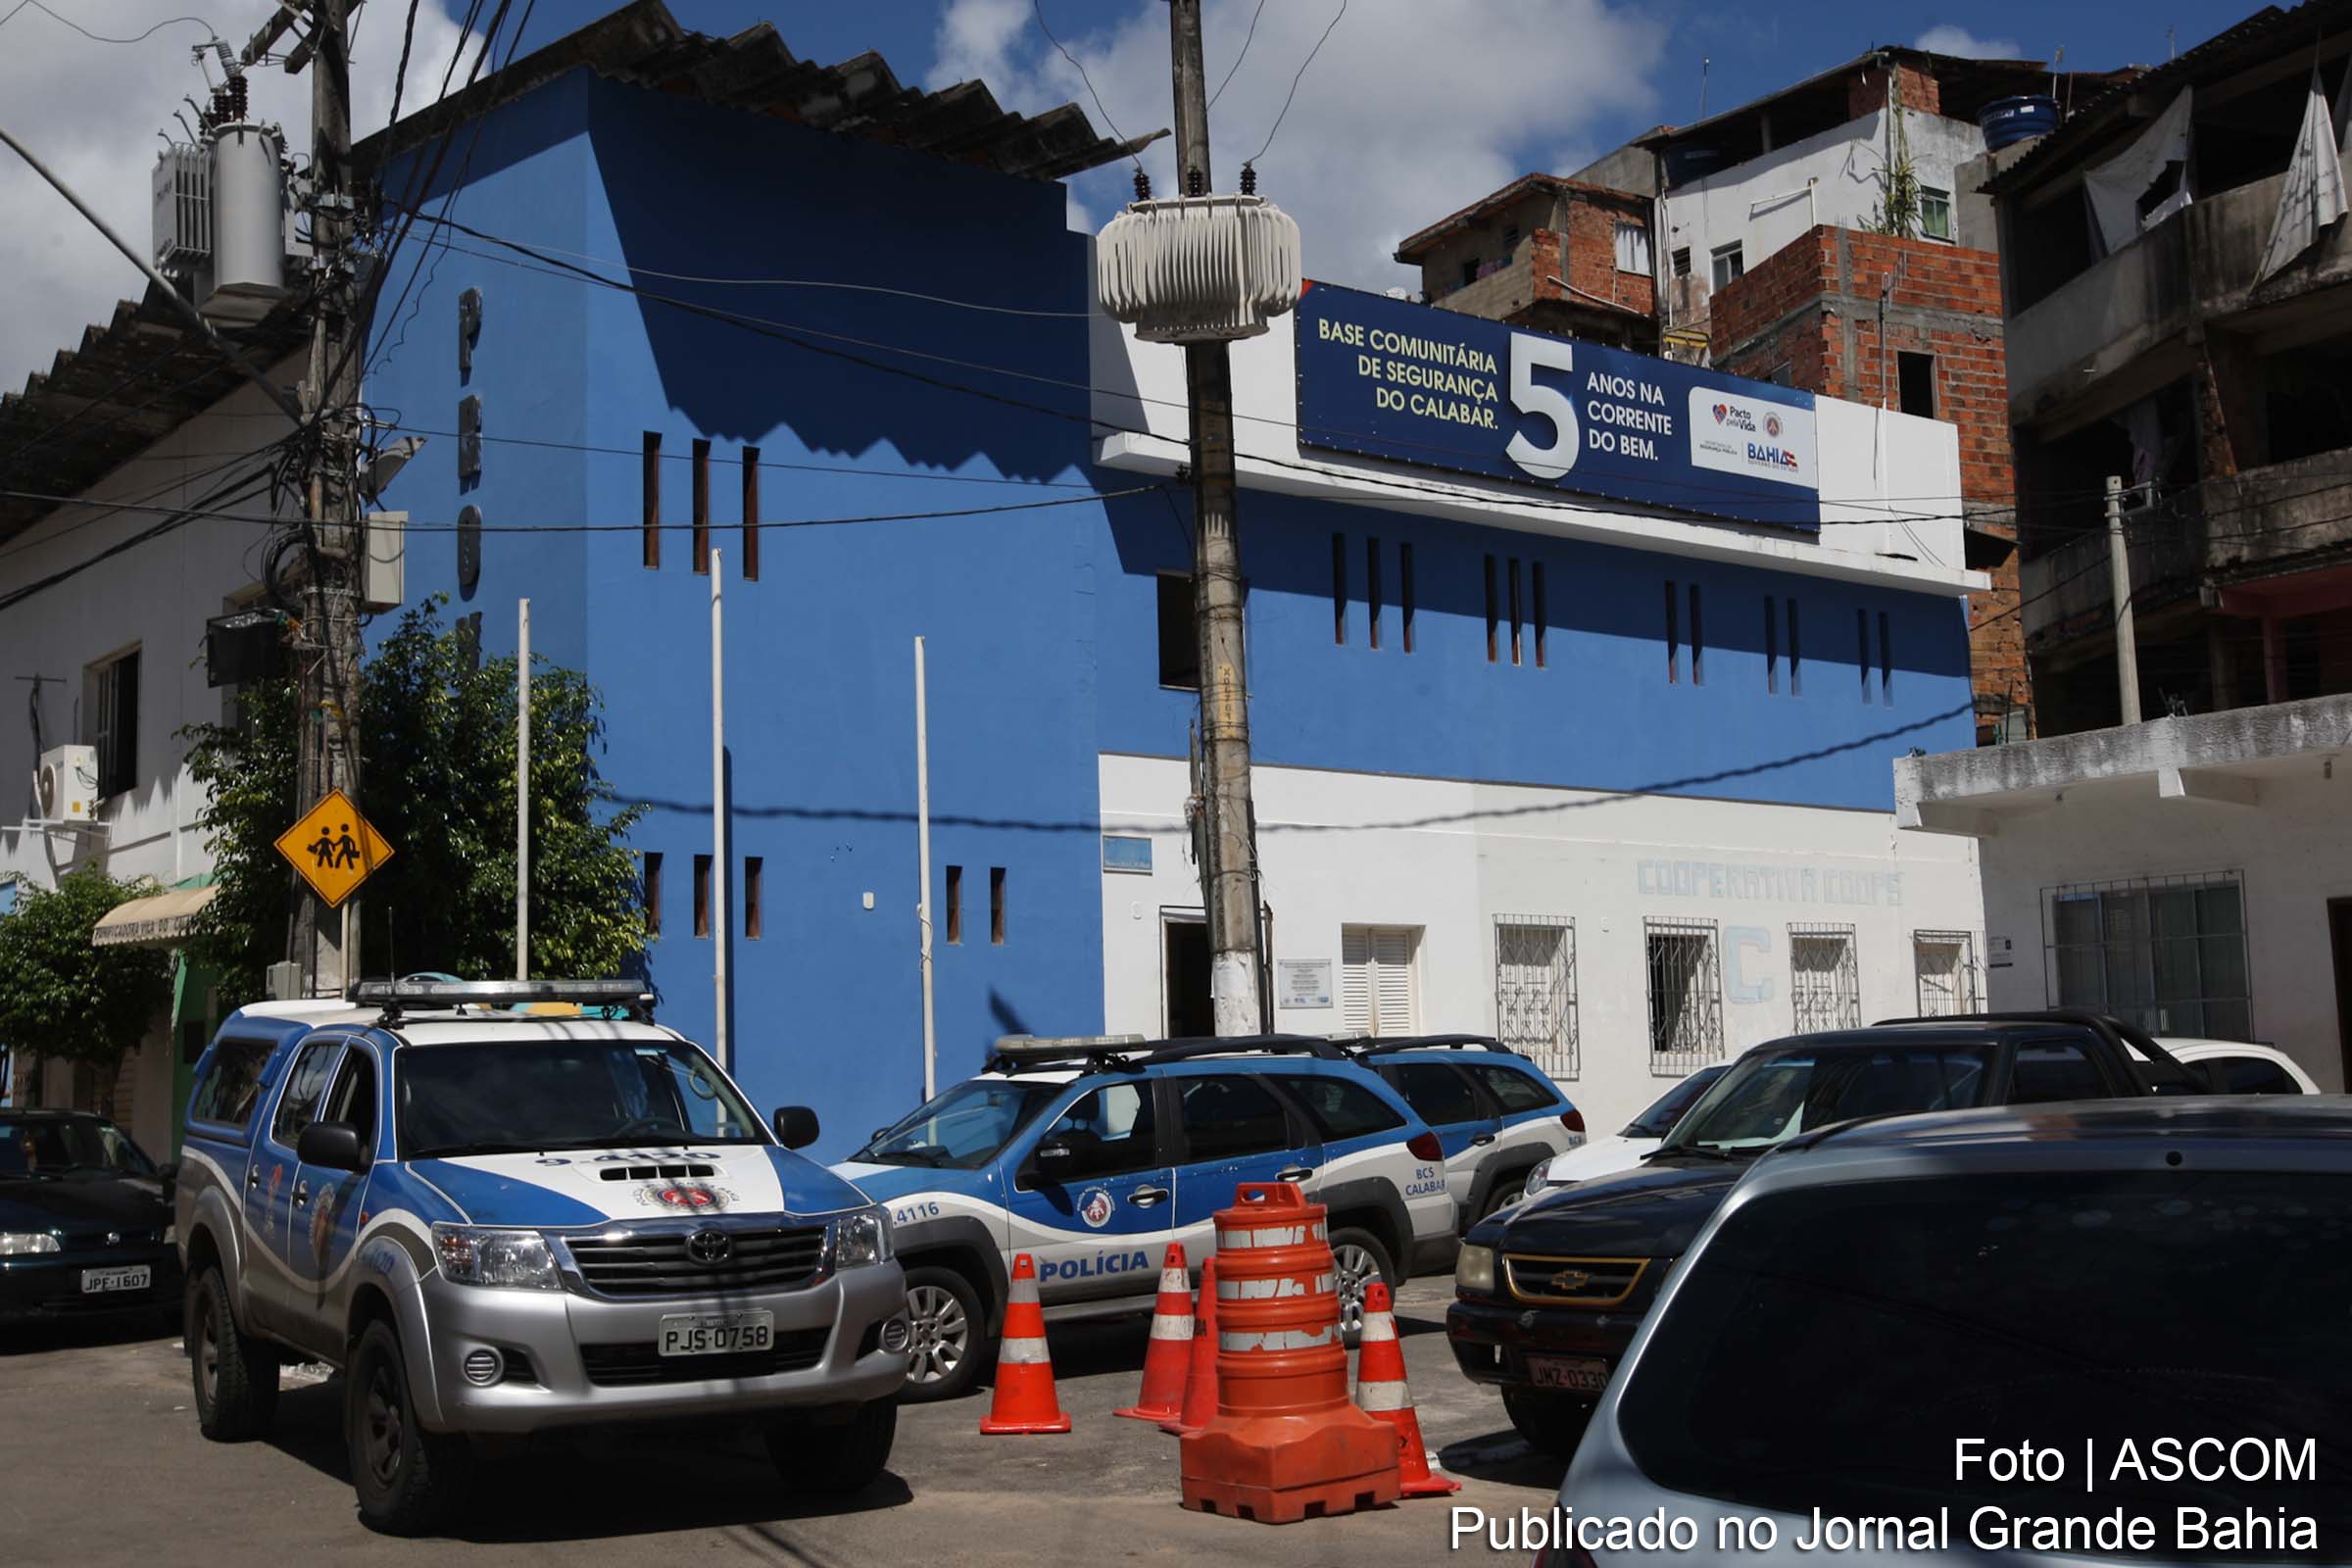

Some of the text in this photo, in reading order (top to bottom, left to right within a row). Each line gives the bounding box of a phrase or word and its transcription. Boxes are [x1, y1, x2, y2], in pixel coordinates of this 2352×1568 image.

[1319, 318, 1497, 374] BASE COMUNITÁRIA
[1358, 355, 1498, 405] DE SEGURANÇA
[1587, 371, 1665, 407] ANOS NA
[1376, 387, 1498, 429] DO CALABAR.
[1505, 331, 1580, 479] 5
[1588, 400, 1672, 435] CORRENTE
[1730, 406, 1751, 420] Pacto
[1589, 428, 1658, 461] DO BEM.
[1747, 442, 1792, 466] BAHIA
[1722, 925, 1774, 1004] C
[1416, 1166, 1435, 1180] BCS
[1040, 1250, 1150, 1283] POLÍCIA
